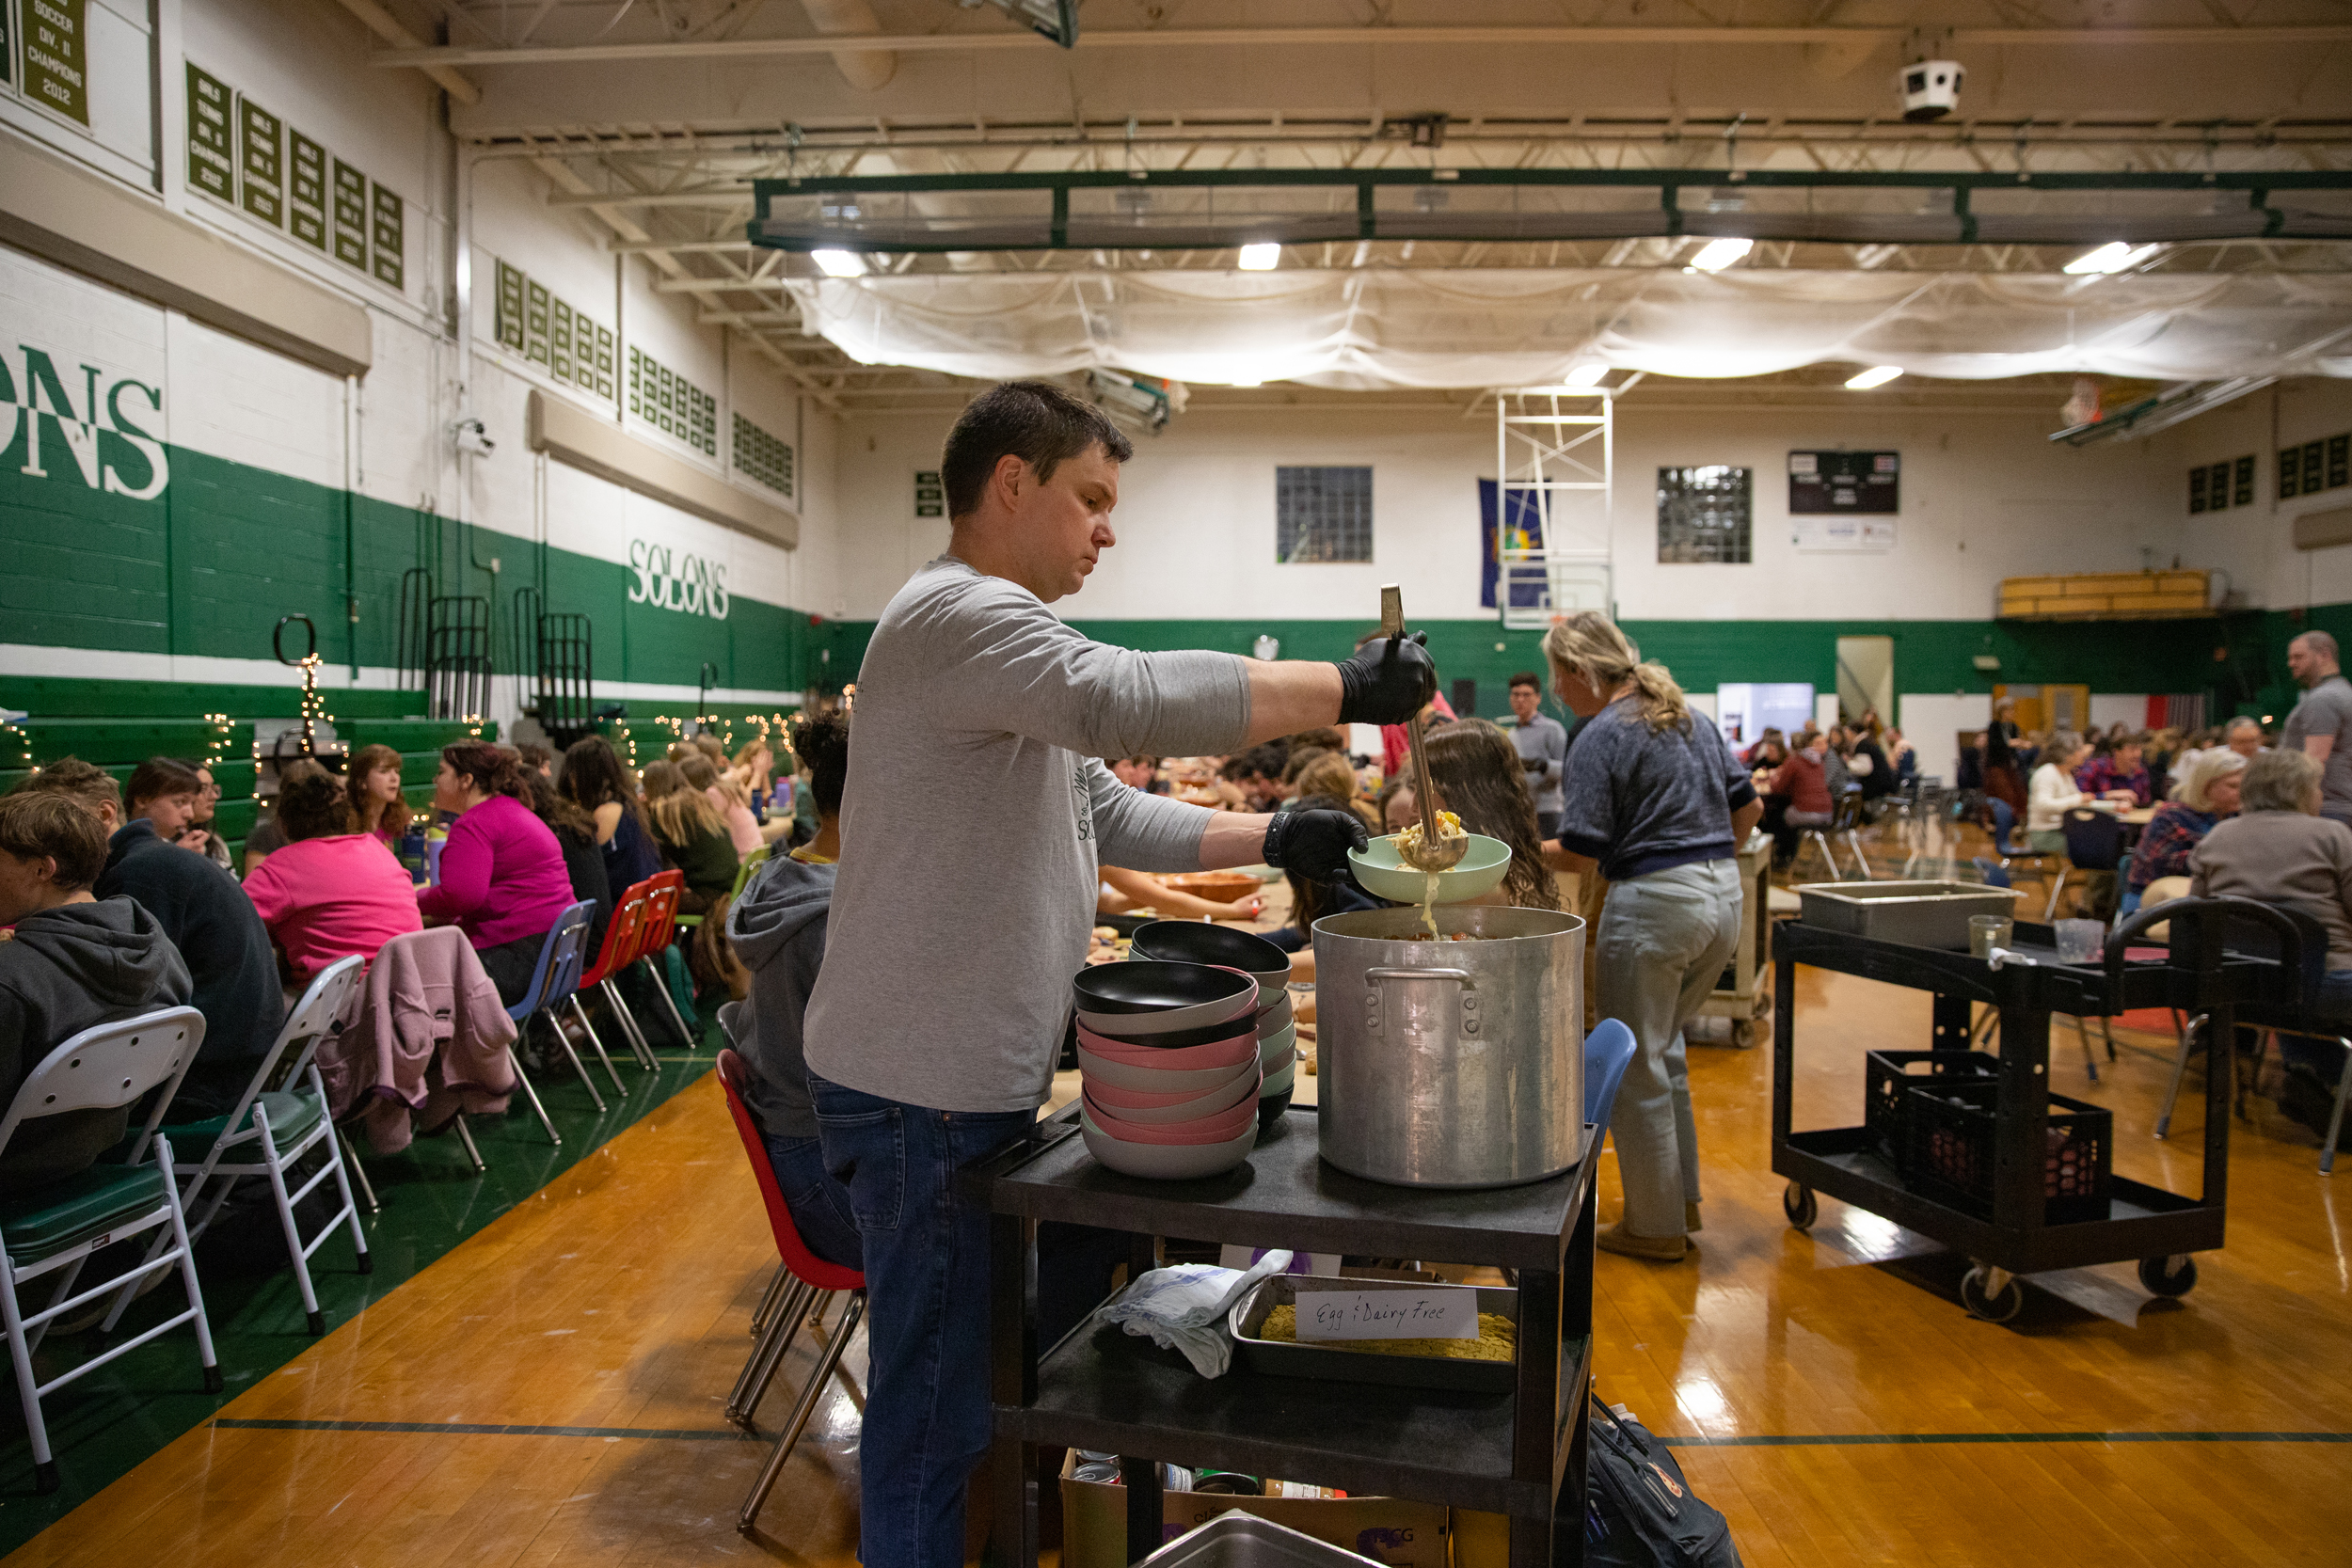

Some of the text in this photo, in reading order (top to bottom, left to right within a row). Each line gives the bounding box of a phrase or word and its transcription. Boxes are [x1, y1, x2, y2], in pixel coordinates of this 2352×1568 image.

[35, 0, 73, 34] SOCCER
[39, 25, 58, 50] DIV.
[27, 44, 82, 88] CHAMPIONS
[43, 77, 72, 106] 2012
[0, 344, 169, 500] NS
[628, 538, 729, 620] SOLONS
[1316, 1303, 1343, 1331] Egg
[1362, 1303, 1407, 1328] Dairy
[1413, 1300, 1445, 1319] Free
